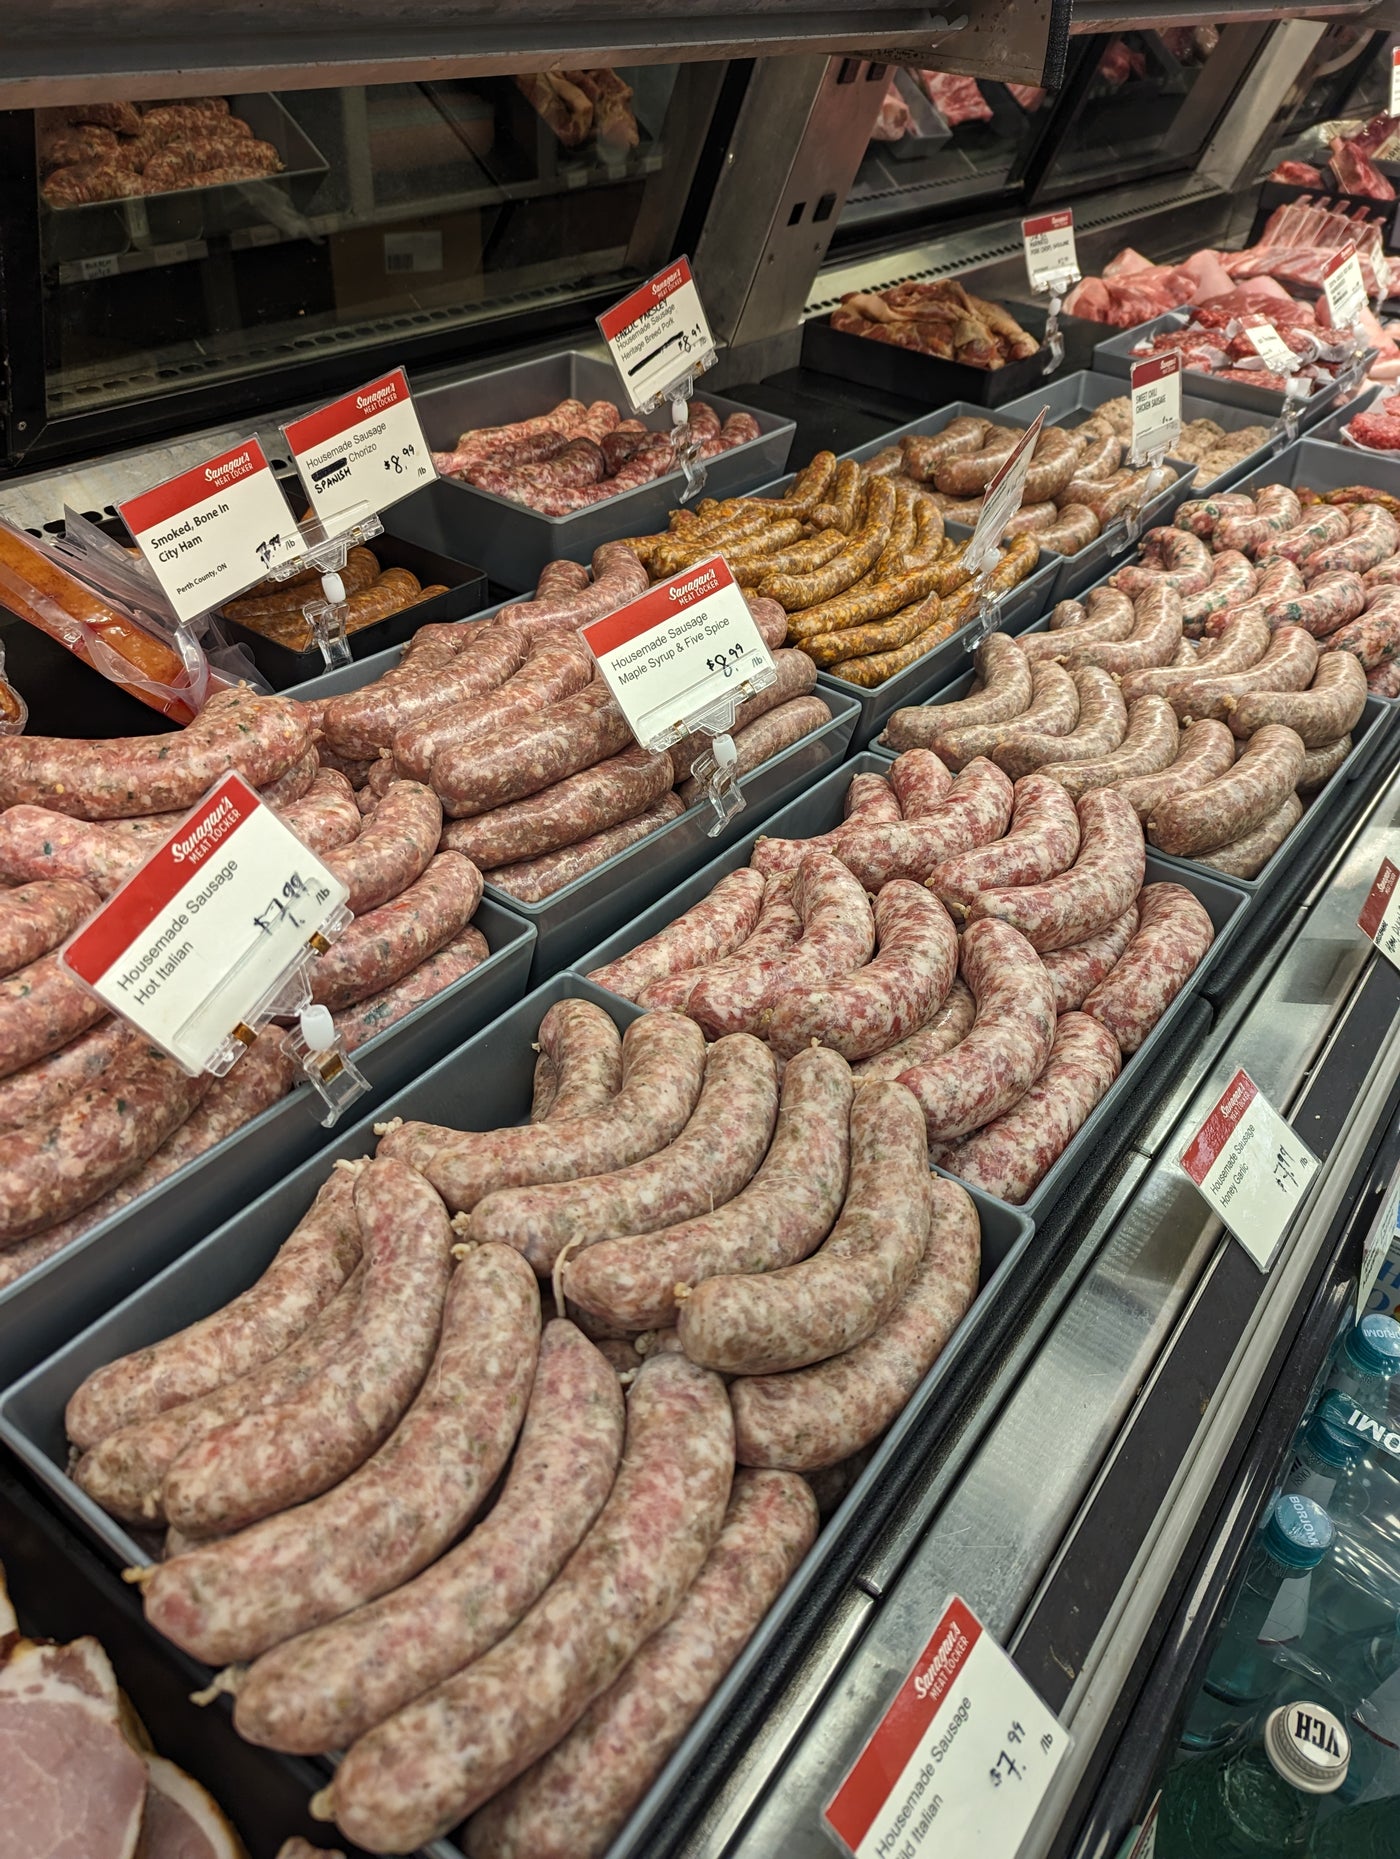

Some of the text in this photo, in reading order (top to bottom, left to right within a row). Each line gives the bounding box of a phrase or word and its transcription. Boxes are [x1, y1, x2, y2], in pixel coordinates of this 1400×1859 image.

[658, 277, 683, 299] MEAT LOCKER
[614, 298, 668, 343] GARLIC PARSLEY
[617, 304, 676, 350] Housemade Sausage
[621, 316, 675, 362] Heritage Breed Pork
[356, 382, 396, 410] Sanagan's
[364, 392, 398, 415] MEAT LOCKER
[204, 452, 250, 482] Sanagan's
[306, 422, 387, 470] Housemade Sausage
[348, 442, 377, 463] Chorizo
[214, 463, 254, 488] MEAT LOCKER
[314, 466, 352, 494] SPANISH
[417, 467, 426, 478] /lb
[150, 502, 230, 550] Smoked, Bone In
[158, 534, 204, 563] City Ham
[285, 539, 296, 552] /lb
[176, 562, 228, 595] Perth County, ON
[668, 568, 716, 601] Sanagan's
[678, 579, 720, 606] MEAT LOCKER
[611, 611, 709, 672] Housemade Sausage
[618, 617, 730, 686] Maple Syrup & Five Spice
[752, 656, 763, 668] /lb
[171, 796, 234, 863] Sanagan's
[188, 808, 241, 864] MEAT LOCKER
[315, 887, 330, 905] /lb
[116, 858, 239, 992] Housemade Sausage
[134, 939, 195, 1006] Hot Italian
[1210, 1124, 1256, 1196] Housemade Sausage
[1300, 1156, 1308, 1169] /lb
[1220, 1162, 1250, 1208] Honey Garlic
[914, 1621, 961, 1699] Sanagan's
[930, 1636, 969, 1701] MEAT LOCKER
[1039, 1732, 1054, 1756] /lb
[1295, 1710, 1340, 1758] VCH
[875, 1696, 972, 1859] Housemade Sausage
[912, 1792, 944, 1844] Italian
